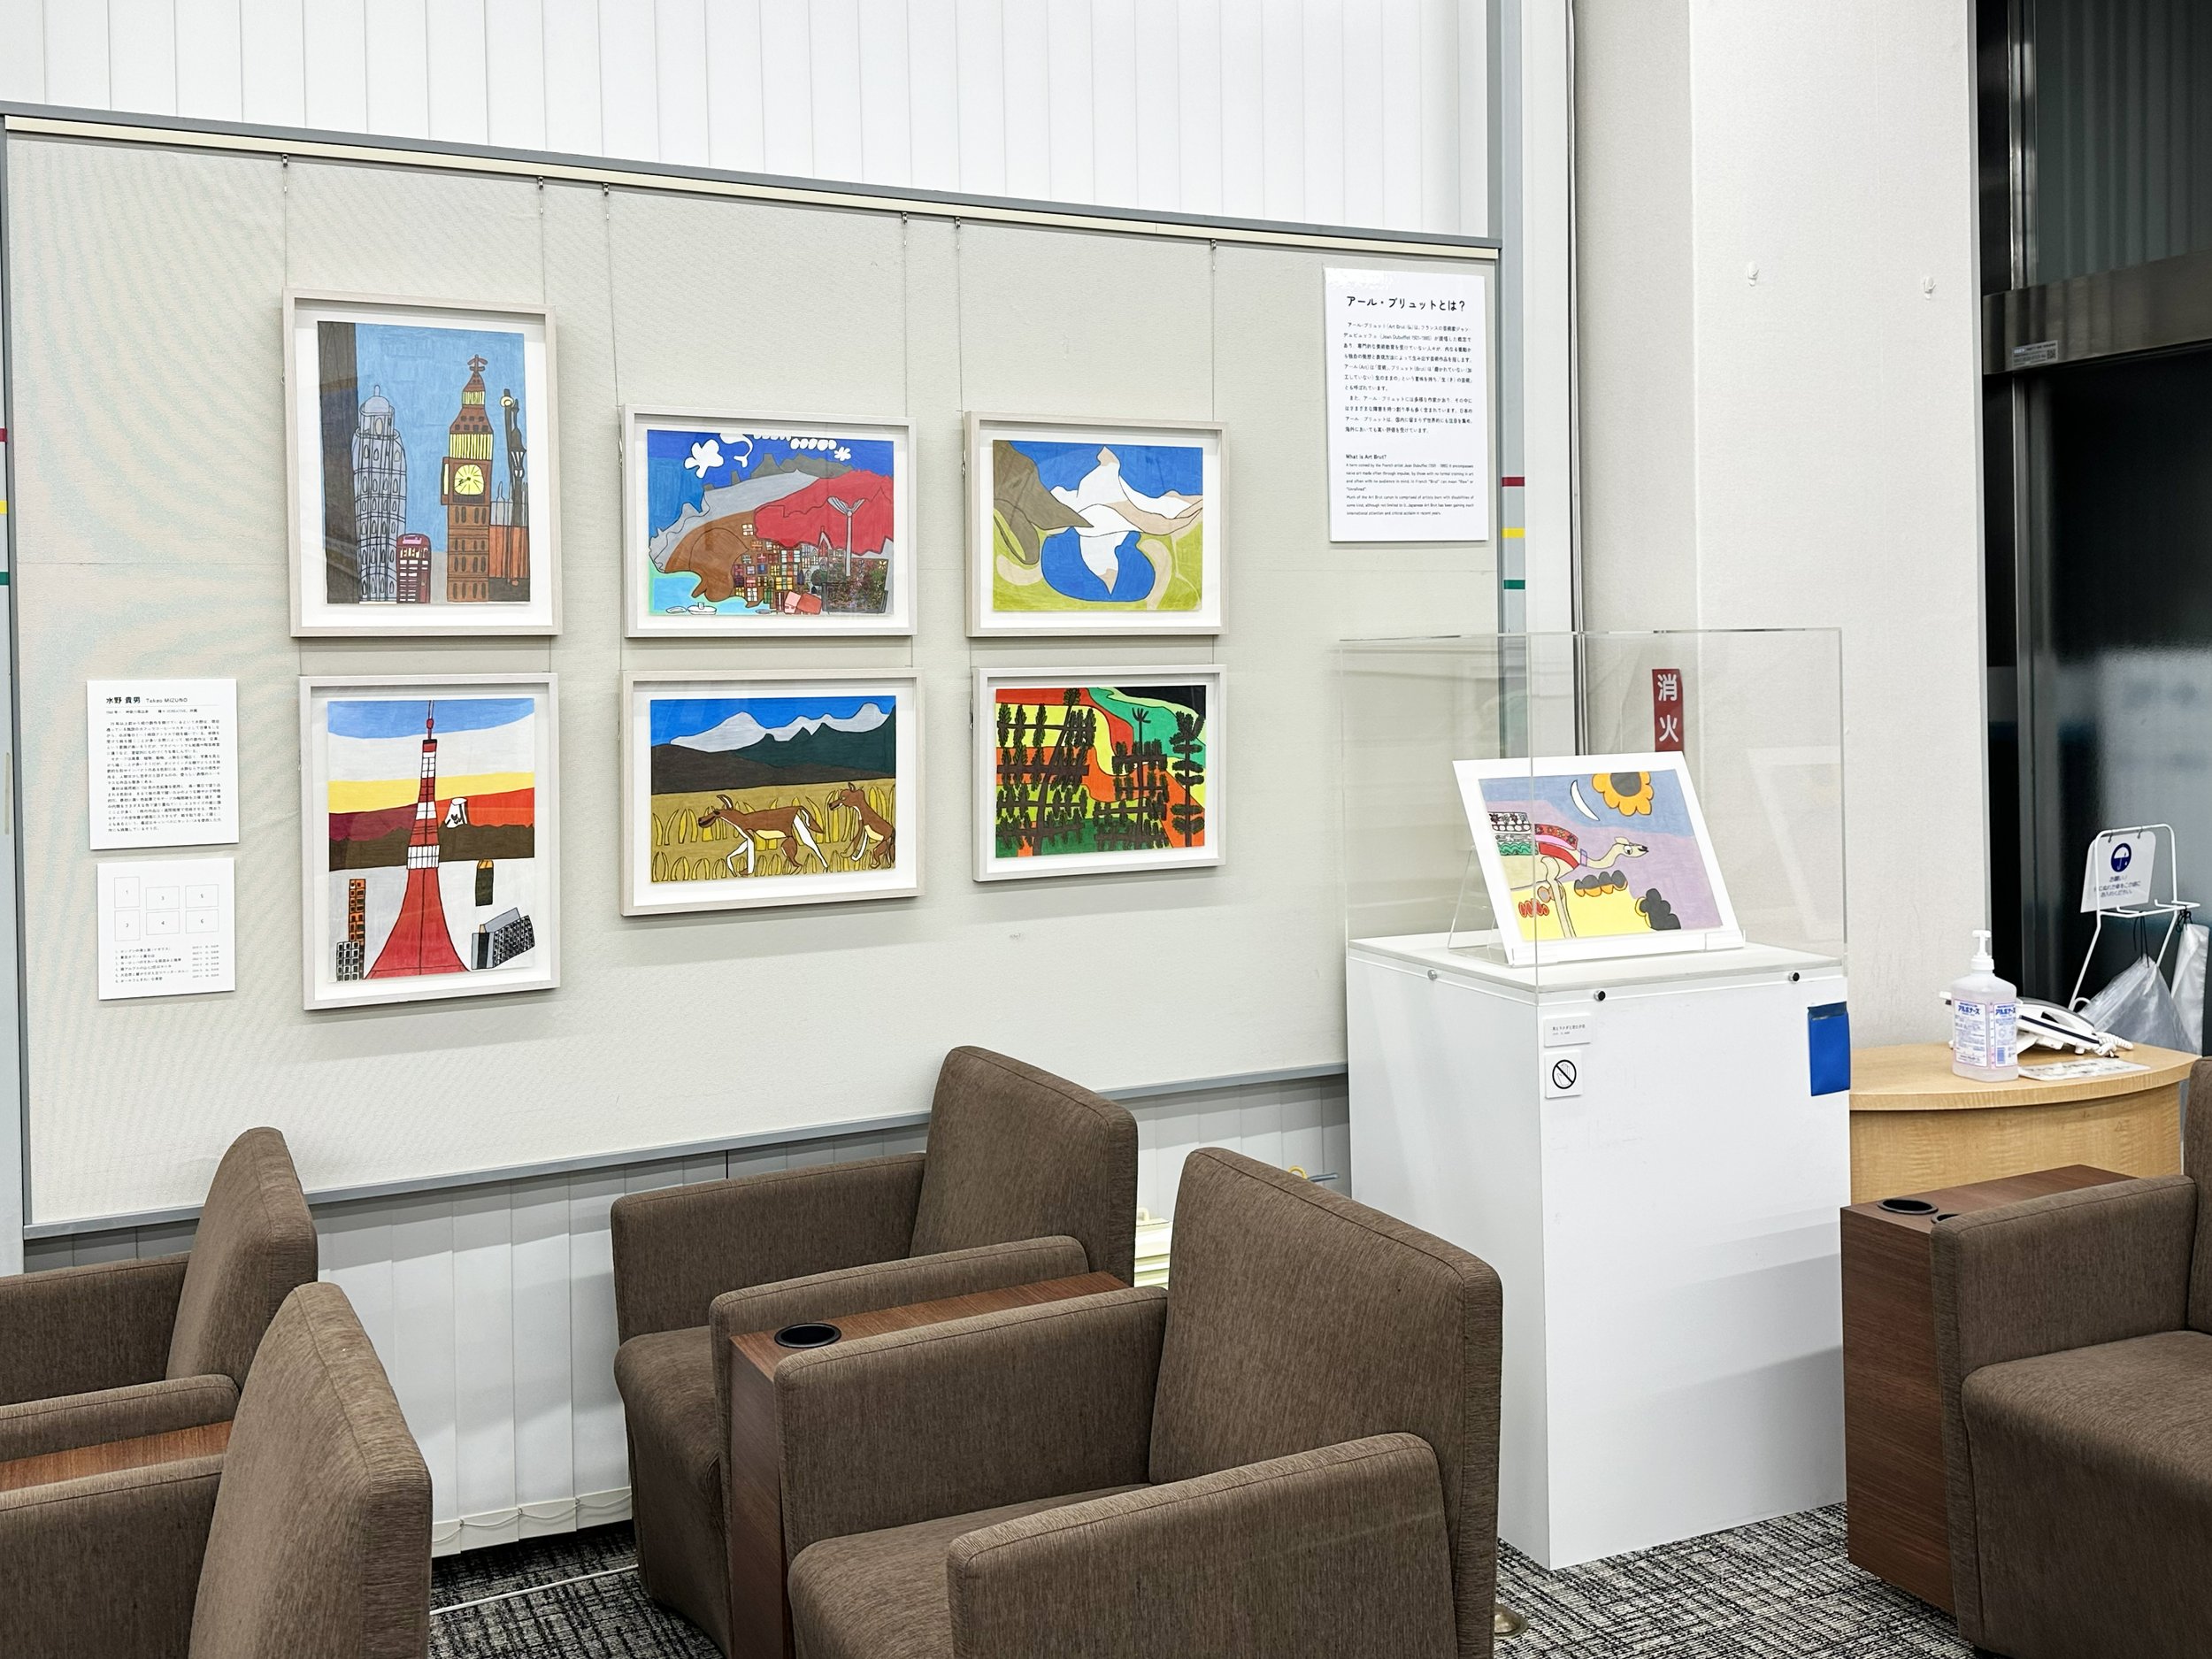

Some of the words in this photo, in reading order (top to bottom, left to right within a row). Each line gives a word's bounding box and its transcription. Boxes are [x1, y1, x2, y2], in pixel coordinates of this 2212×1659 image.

[1347, 296, 1465, 311] アール・ブリュットとは？
